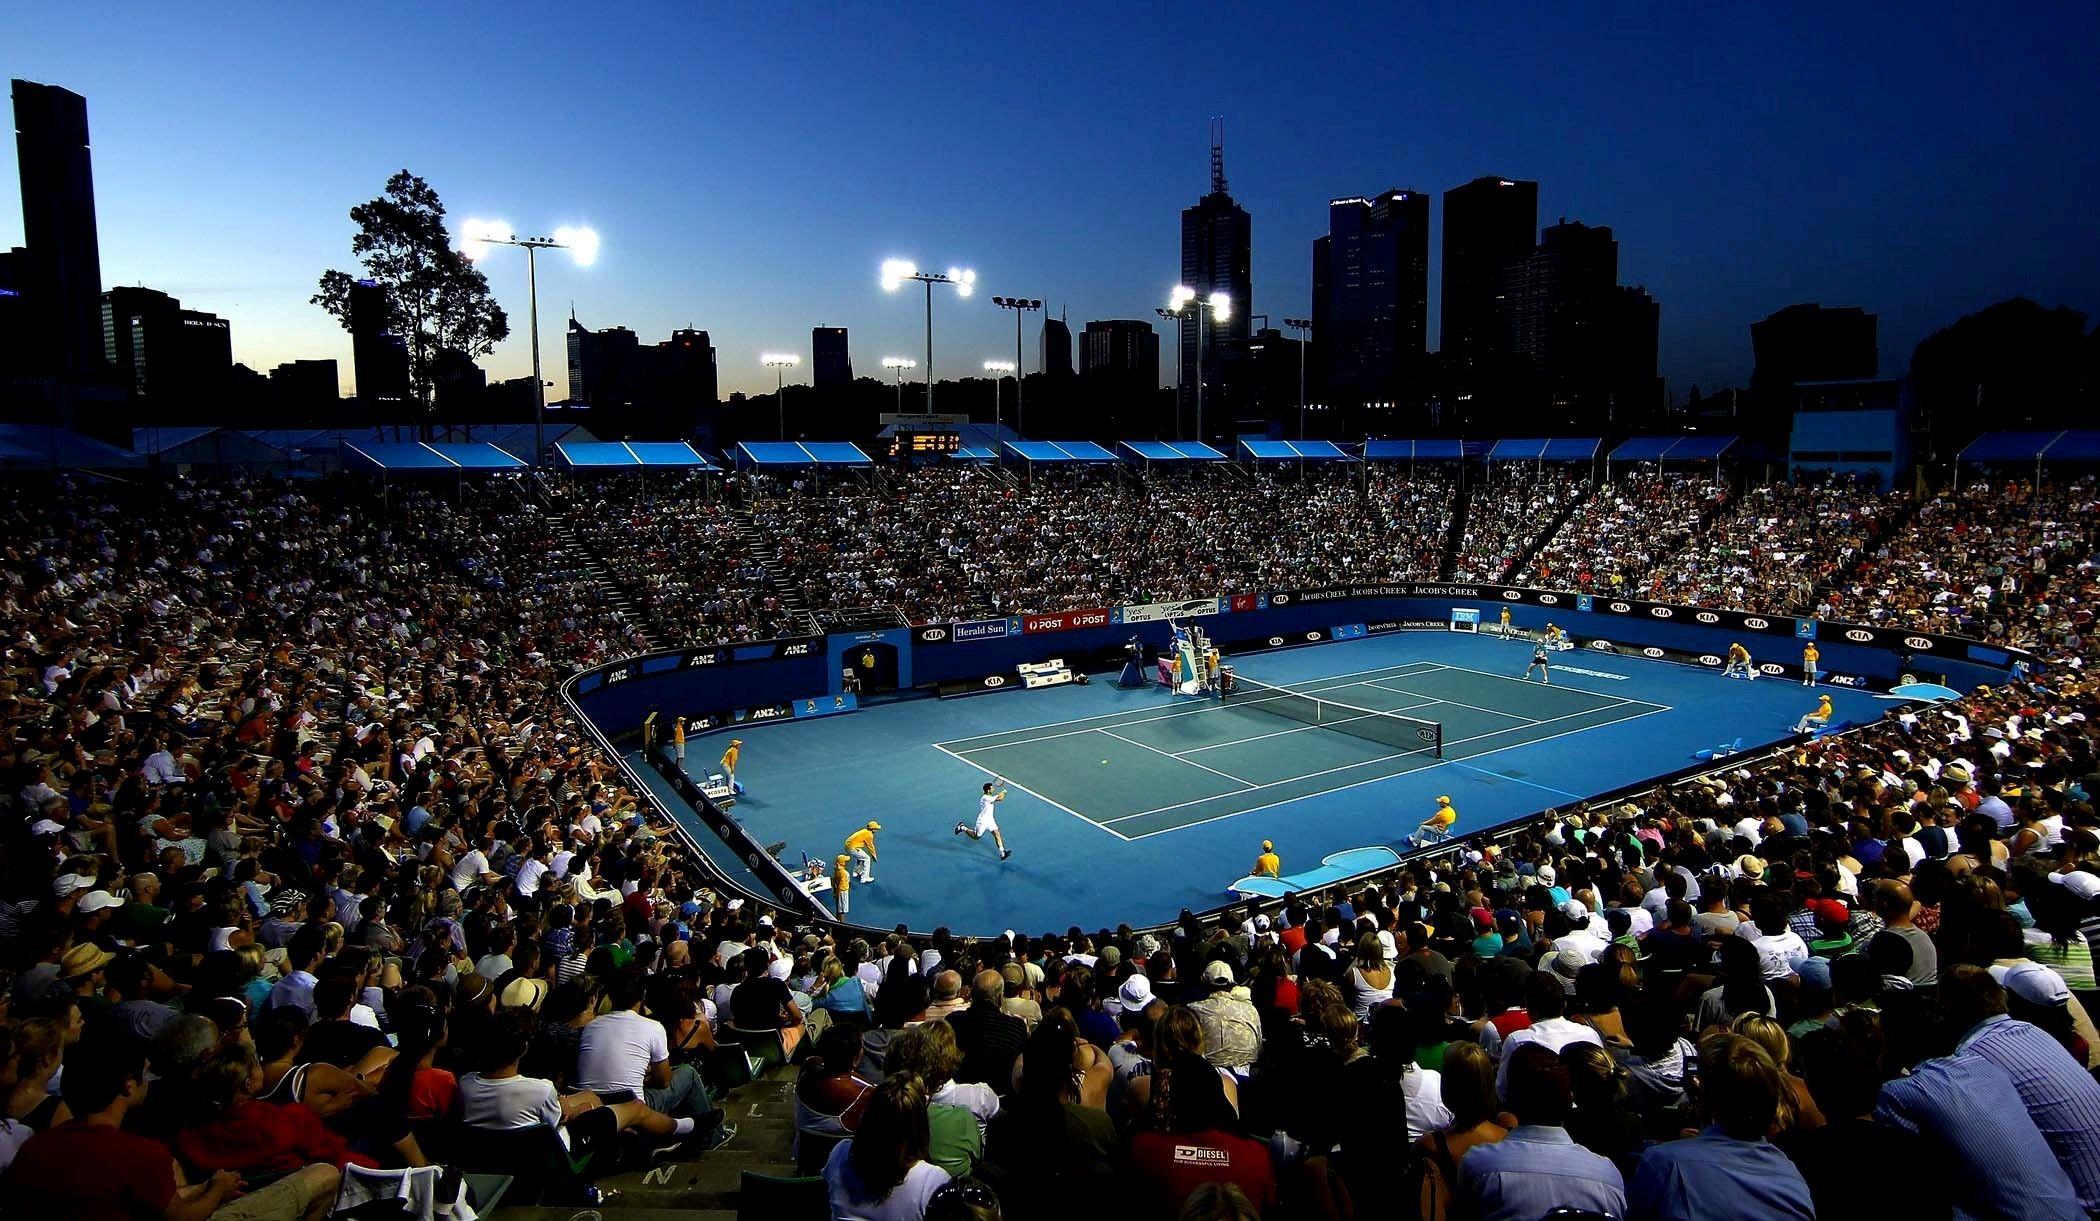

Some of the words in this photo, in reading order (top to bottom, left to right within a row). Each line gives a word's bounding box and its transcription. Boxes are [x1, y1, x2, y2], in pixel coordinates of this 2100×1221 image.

[1300, 592, 1325, 601] JACOB'S
[1325, 590, 1347, 599] CREEK
[1351, 587, 1379, 596] JACOB'S
[1379, 586, 1407, 595] CREEK
[1413, 585, 1447, 594] JACOB'S
[1448, 586, 1479, 596] CREEK
[1197, 607, 1216, 615] OPTUS
[1082, 615, 1105, 625] POST
[1131, 614, 1151, 622] OPTUS
[1039, 619, 1063, 629] POST
[957, 626, 986, 637] Herald
[987, 624, 1004, 634] Sun
[784, 644, 808, 656] ANZ
[690, 654, 715, 666] ANZ
[609, 669, 628, 683] ANZ
[1830, 675, 1855, 686] ANZ
[753, 708, 776, 719] ANZ
[690, 718, 710, 732] ANZ
[707, 788, 727, 796] ACOSTE
[1198, 1149, 1226, 1159] DIESEL
